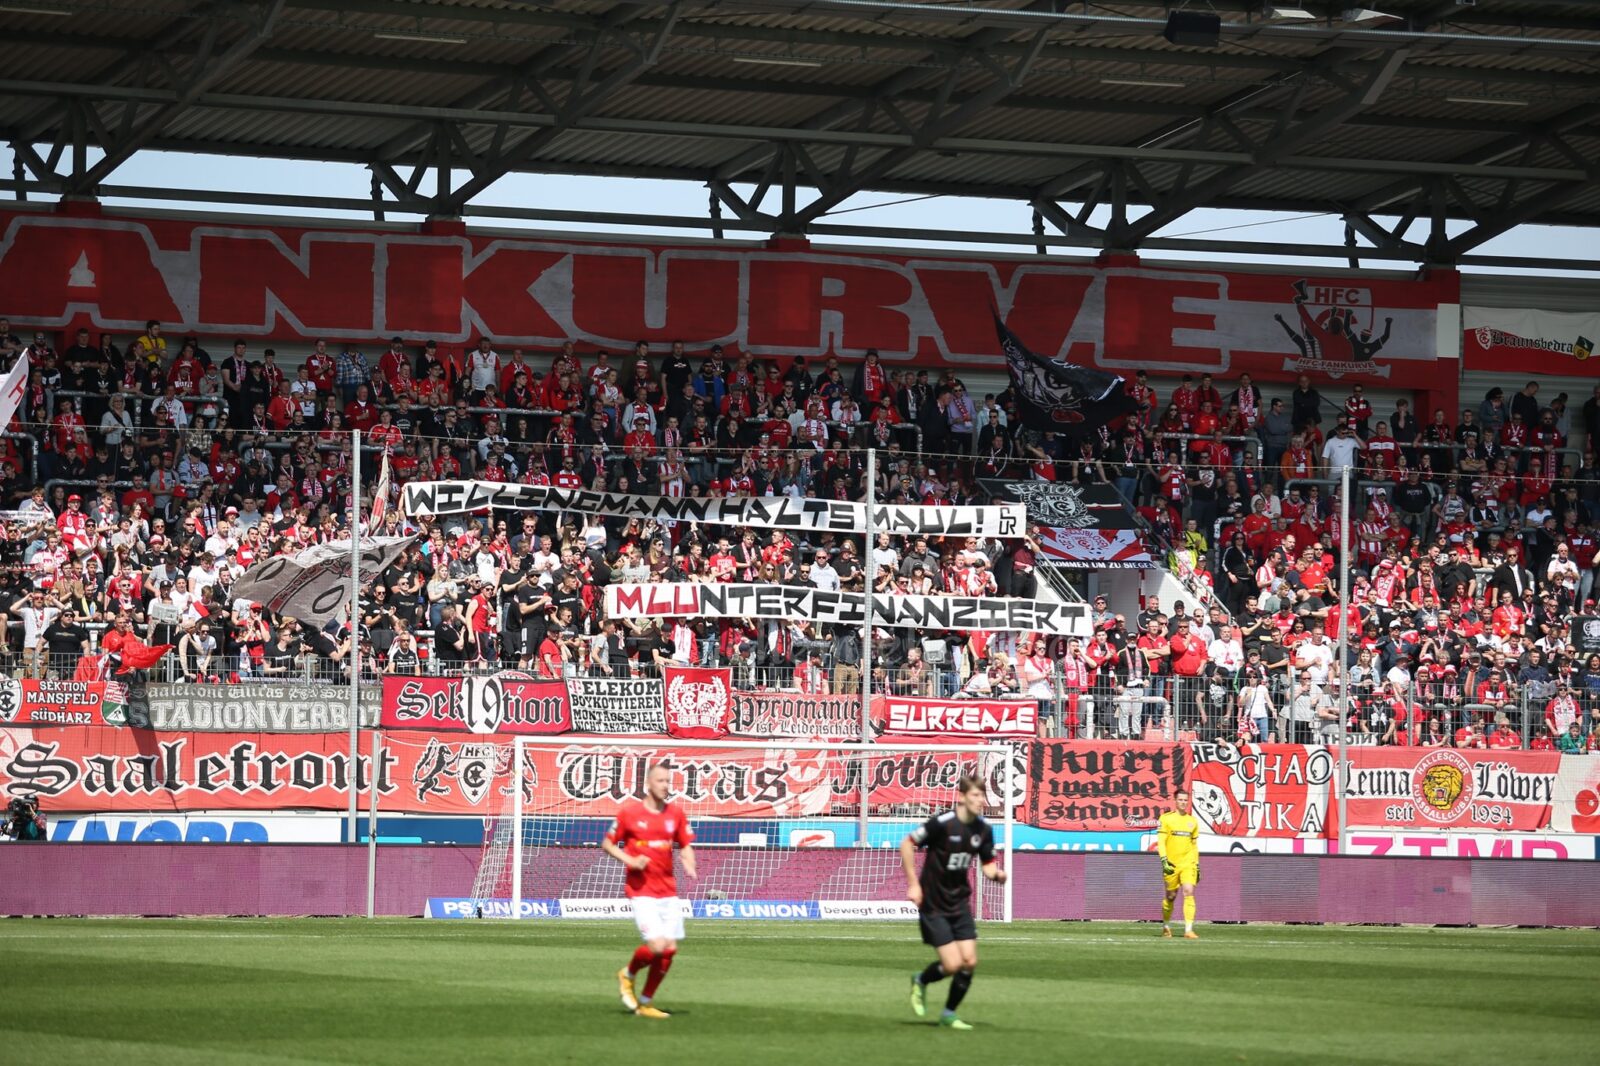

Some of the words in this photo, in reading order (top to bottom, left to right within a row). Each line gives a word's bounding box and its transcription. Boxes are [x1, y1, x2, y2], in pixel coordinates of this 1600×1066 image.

[1315, 287, 1360, 304] HFC
[408, 483, 709, 520] WILLINGMANN
[719, 498, 855, 529] HALTS
[865, 506, 984, 533] MAUL!
[39, 681, 87, 691] SEKTION
[27, 692, 99, 705] MANSFELD
[572, 695, 662, 710] BOYKOTTIEREN
[31, 707, 92, 723] SÜDHARZ
[889, 705, 1036, 732] SURREALE
[1416, 752, 1469, 775] HALLESCHER
[1240, 800, 1324, 833] TIKA
[1386, 803, 1414, 821] seit
[1471, 804, 1512, 824] 1984
[443, 902, 473, 914] PS
[565, 905, 616, 915] bewegt
[619, 905, 632, 914] di
[706, 904, 735, 917] PS
[740, 904, 807, 917] UNION
[824, 906, 873, 916] bewegt
[878, 906, 896, 915] die
